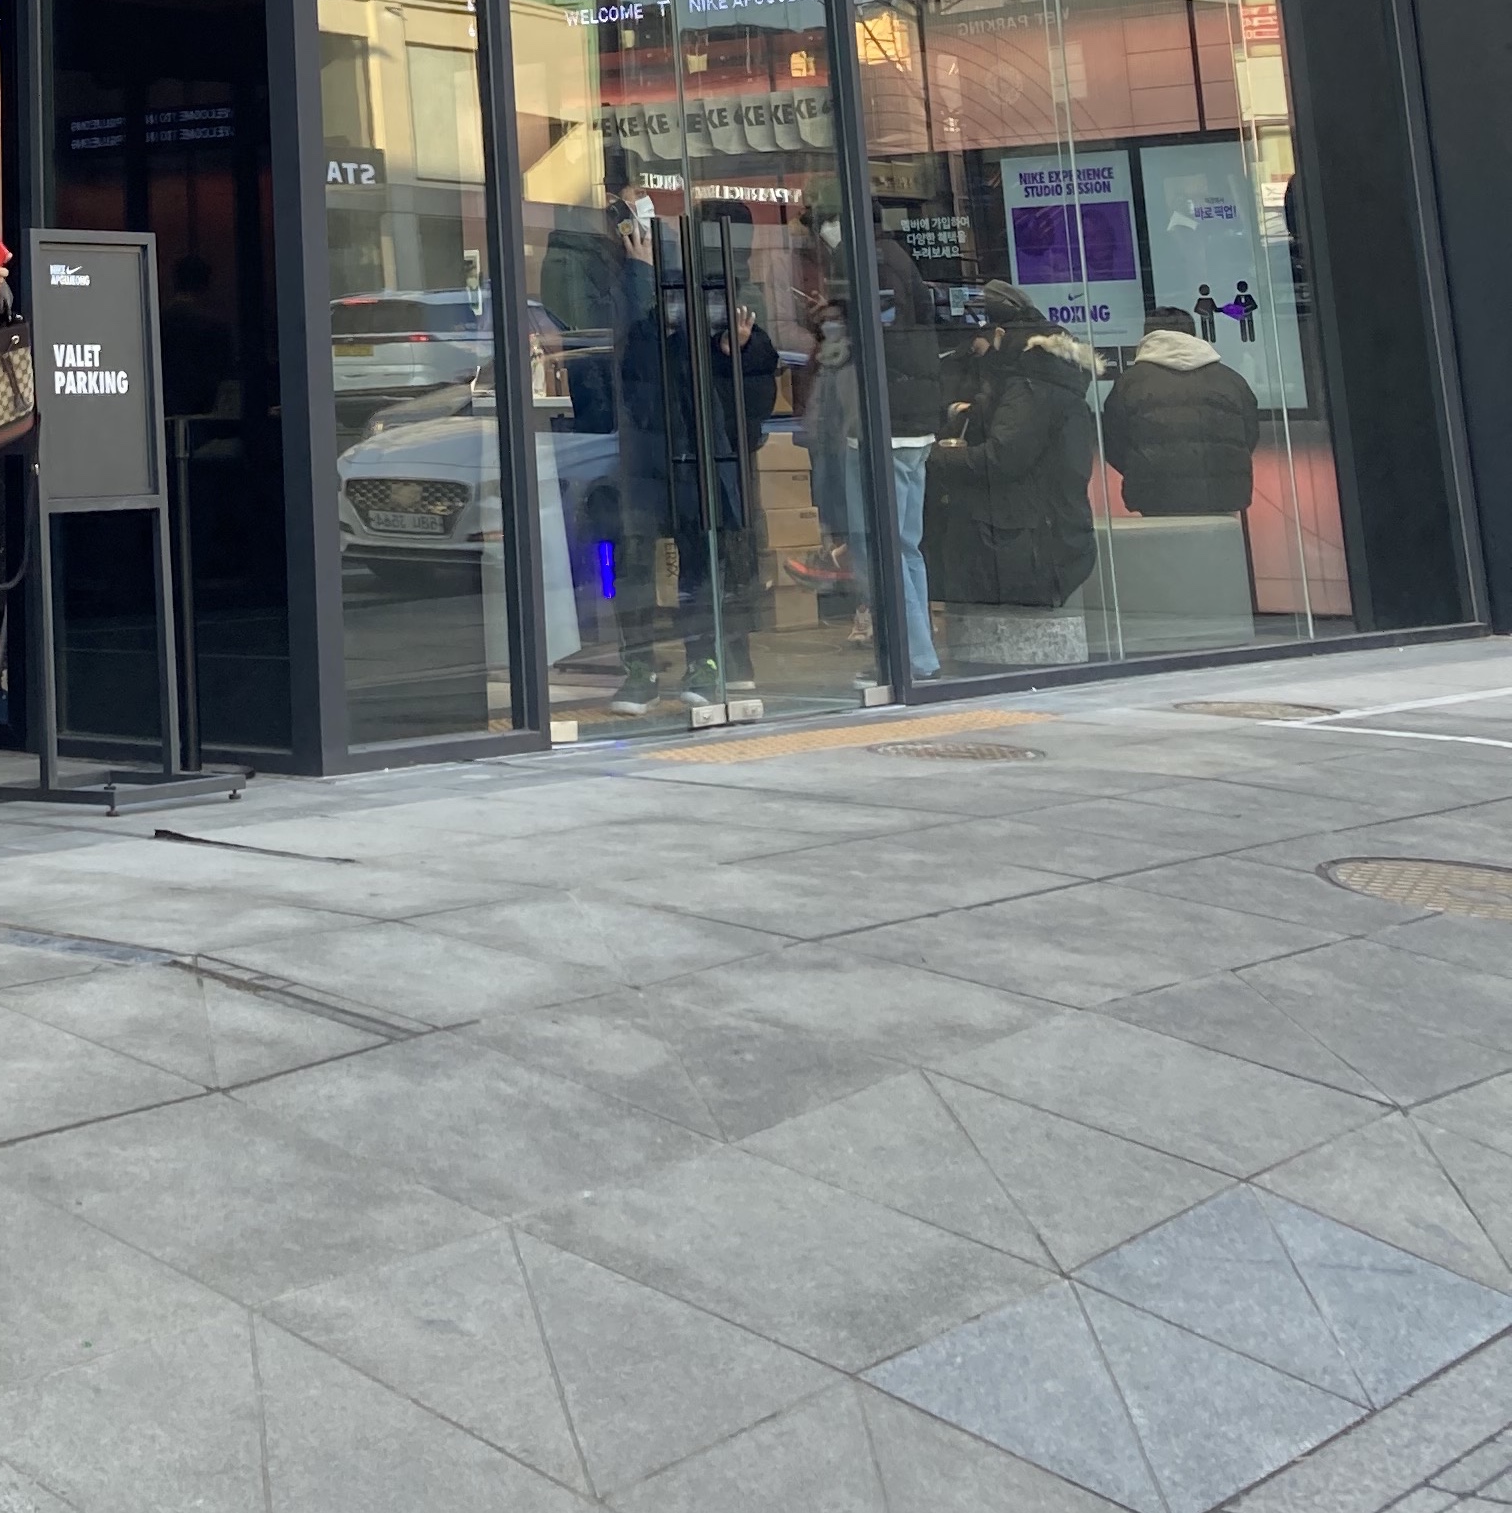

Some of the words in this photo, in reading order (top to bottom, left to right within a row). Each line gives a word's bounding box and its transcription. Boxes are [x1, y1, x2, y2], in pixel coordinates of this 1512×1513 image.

[564, 3, 644, 26] WELCOME
[657, 0, 670, 16] T
[1019, 171, 1045, 185] NIKE
[1024, 184, 1063, 198] STUDIO
[1194, 206, 1214, 220] 바로
[900, 217, 930, 232] 멤버에
[931, 215, 970, 230] 가입하여
[906, 231, 936, 246] 다양한
[1048, 304, 1110, 324] BOXING
[53, 344, 101, 367] VALET
[54, 370, 129, 395] PARKING
